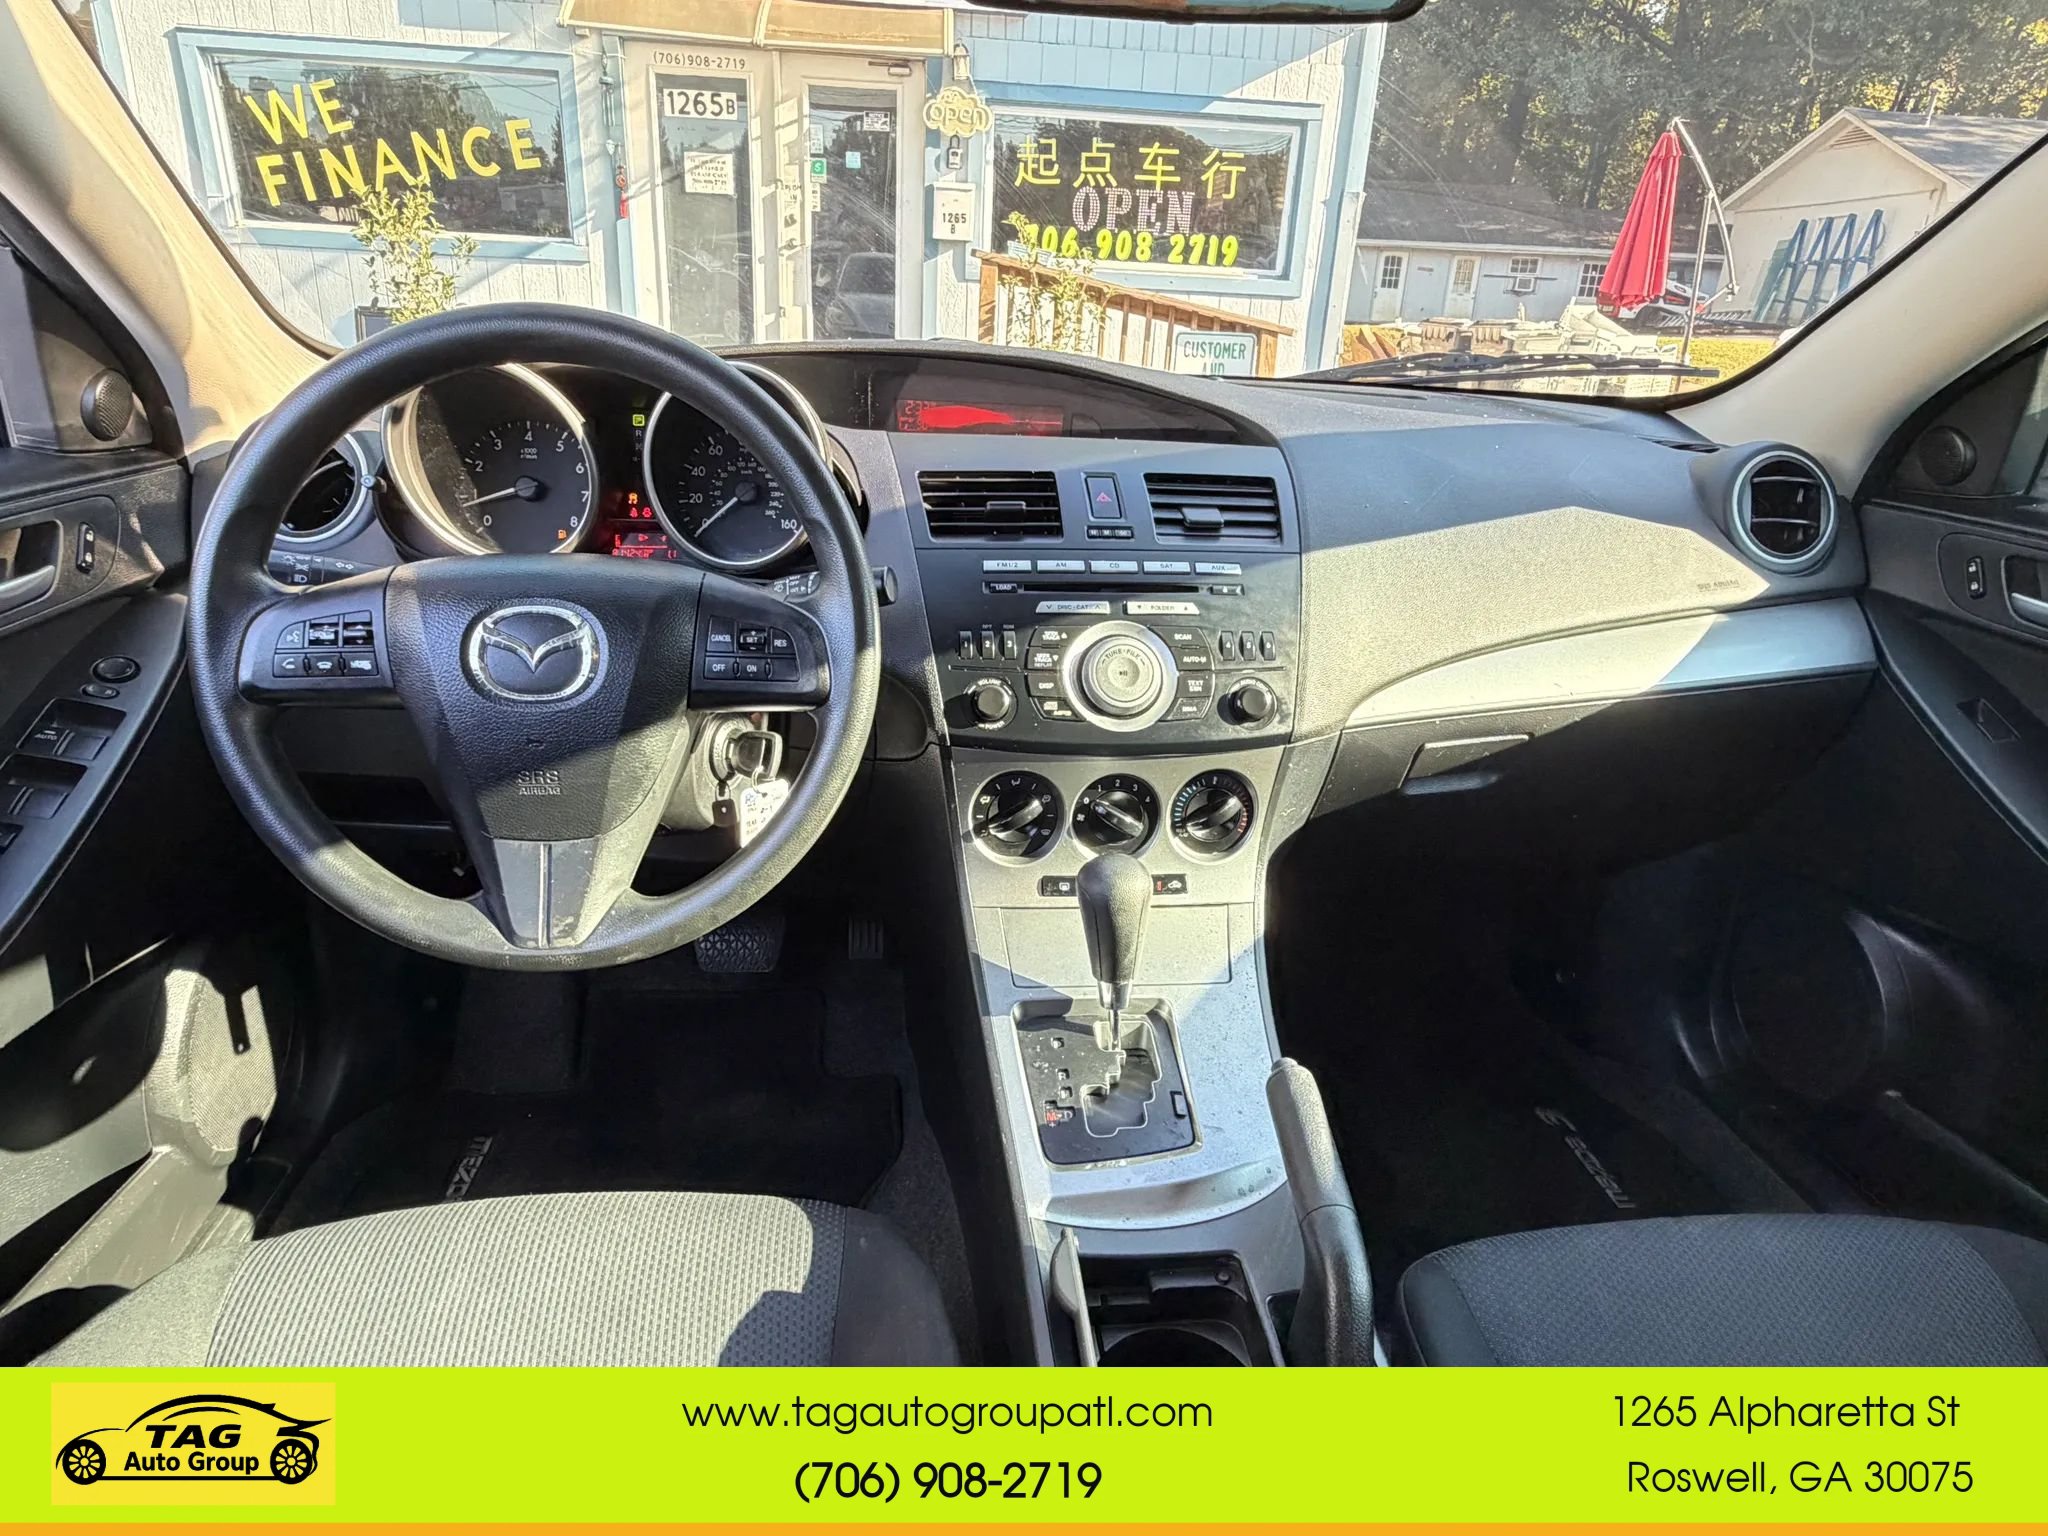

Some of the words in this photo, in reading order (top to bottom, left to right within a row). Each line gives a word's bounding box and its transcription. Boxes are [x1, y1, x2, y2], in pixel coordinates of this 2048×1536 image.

[653, 51, 746, 70] (706)908-2719
[244, 79, 354, 145] WE
[255, 119, 542, 207] FINANCE
[1014, 135, 1247, 200] 起点车行
[1072, 186, 1195, 236] OPEN
[942, 213, 967, 224] 1265
[1096, 228, 1153, 262] 908
[1167, 233, 1239, 266] 2719
[1183, 341, 1247, 360] CUSTOMER
[524, 431, 533, 441] 4
[494, 439, 502, 451] 3
[556, 440, 564, 452] 5
[708, 445, 723, 456] 60
[475, 460, 483, 472] 2
[575, 462, 585, 474] 6
[690, 465, 706, 477] 40
[580, 490, 590, 502] 7
[688, 493, 703, 504] 20
[483, 515, 492, 526] 0
[570, 516, 578, 528] 8
[780, 519, 798, 530] 160
[711, 634, 732, 642] CANCEL
[1174, 633, 1193, 641] SCAN
[773, 639, 787, 648] RES
[985, 640, 990, 648] 2
[1007, 640, 1013, 648] 3
[1225, 641, 1231, 649] 4
[712, 663, 726, 672] OFF
[746, 664, 758, 673] ON
[35, 733, 57, 741] AUTO
[518, 770, 559, 784] SRS
[1097, 784, 1102, 792] 1
[1115, 779, 1121, 787] 2
[1133, 784, 1138, 792] 3
[519, 786, 561, 795] AIRBAG
[1047, 1111, 1057, 1121] M
